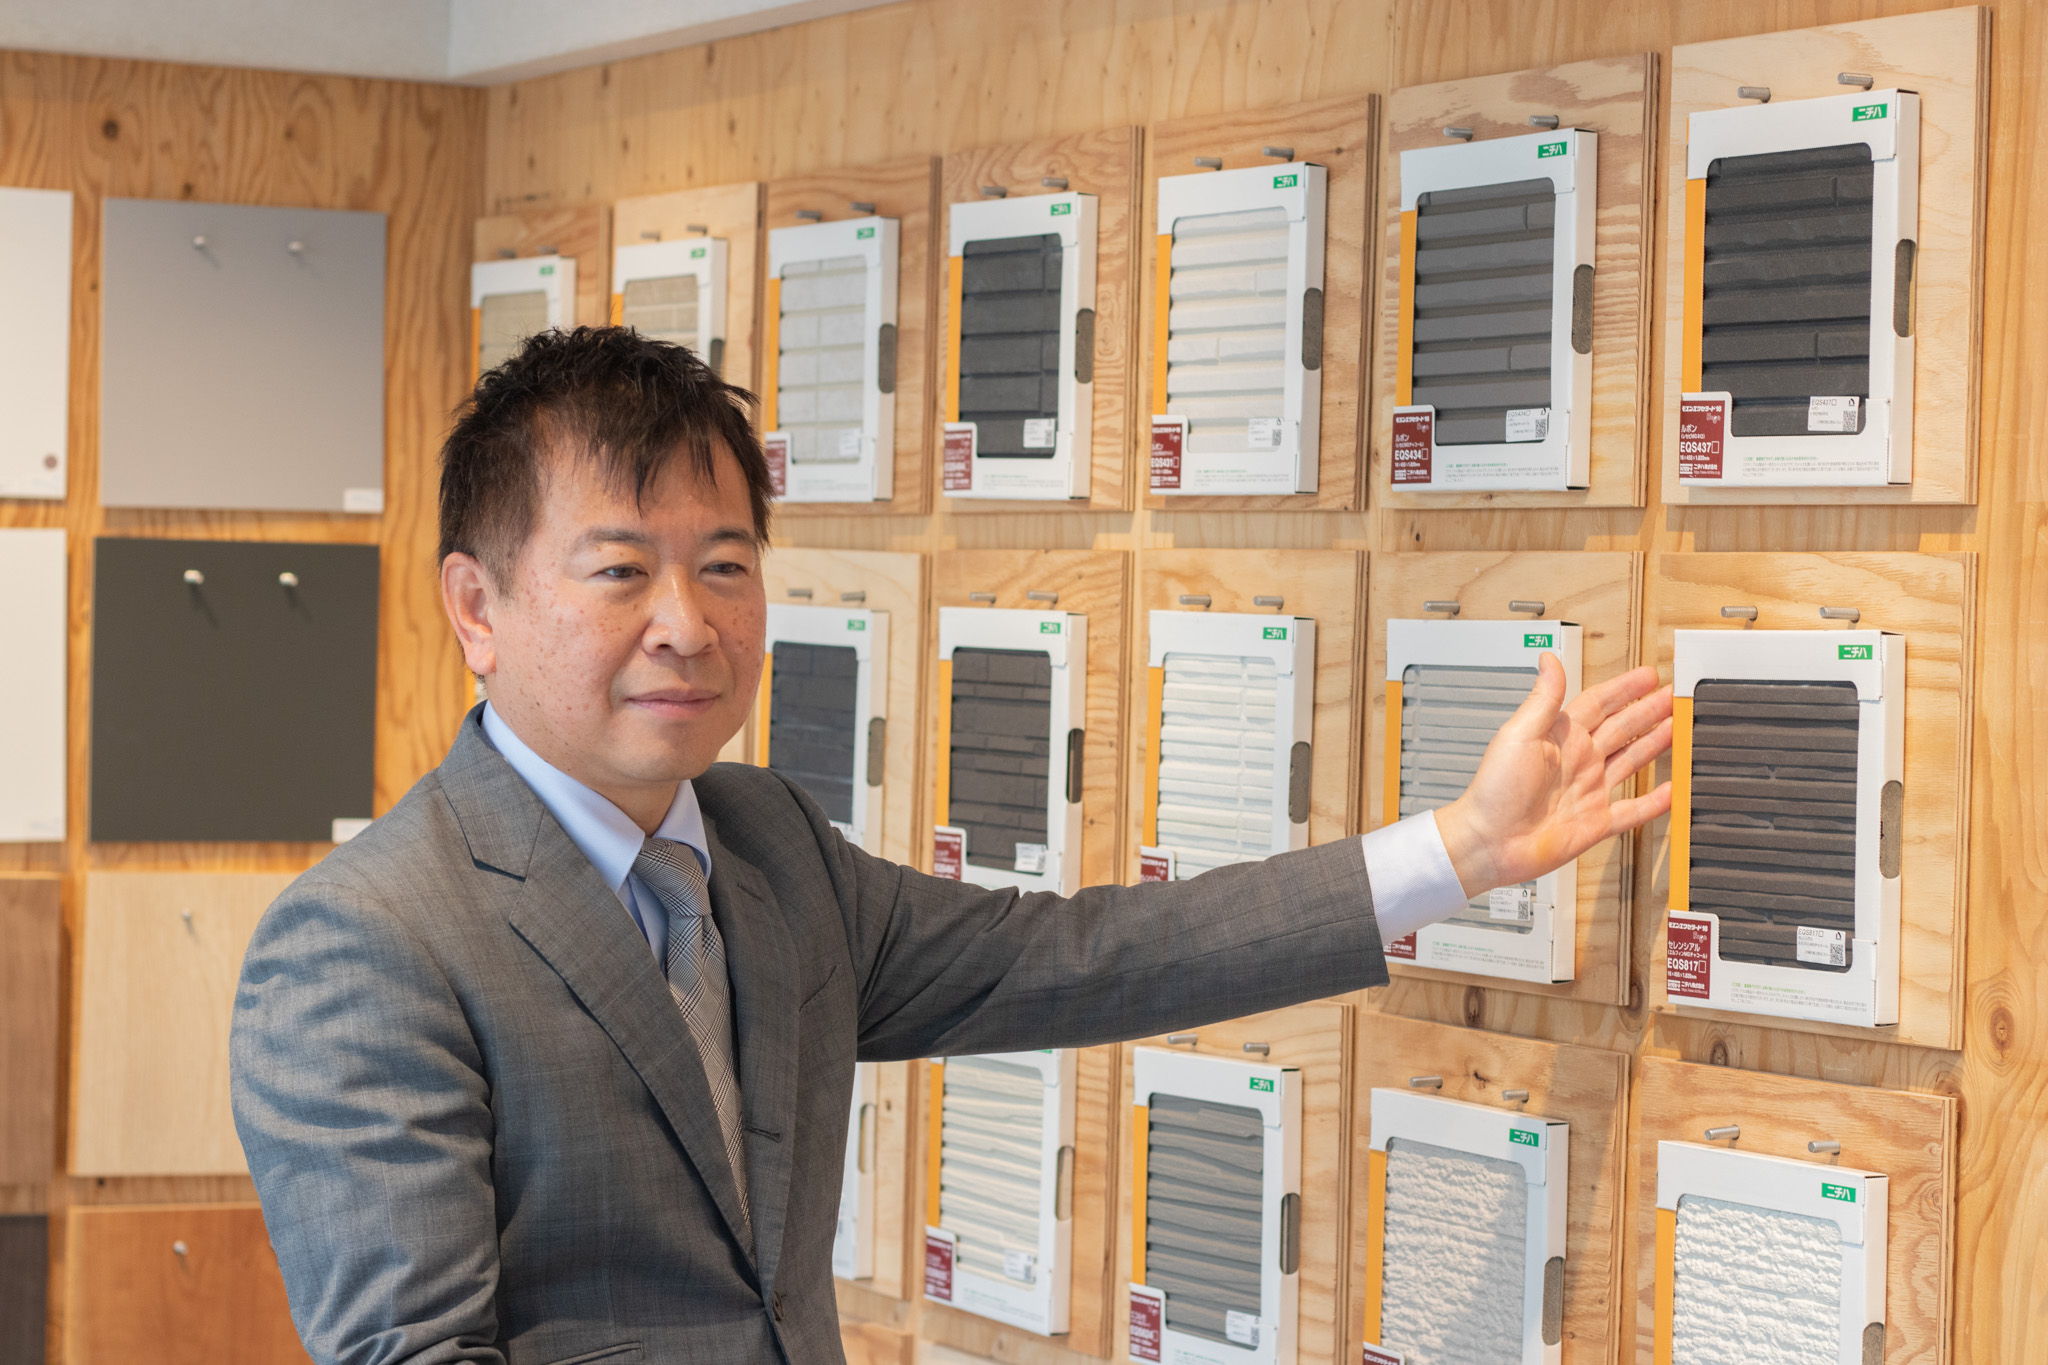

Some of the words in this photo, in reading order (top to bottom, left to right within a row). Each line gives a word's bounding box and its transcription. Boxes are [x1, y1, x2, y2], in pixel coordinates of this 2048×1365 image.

[1857, 106, 1882, 119] ニチハ
[1542, 144, 1563, 156] ニチハ
[1276, 176, 1294, 187] ニチハ
[1266, 628, 1283, 639] ニチハ
[1528, 635, 1548, 646] ニチハ
[1843, 646, 1867, 658] ニチハ
[1668, 940, 1700, 952] セレンシアル
[1253, 1079, 1270, 1091] ニチハ
[1513, 1131, 1534, 1145] ニチハ
[1826, 1185, 1851, 1201] ニチハ
